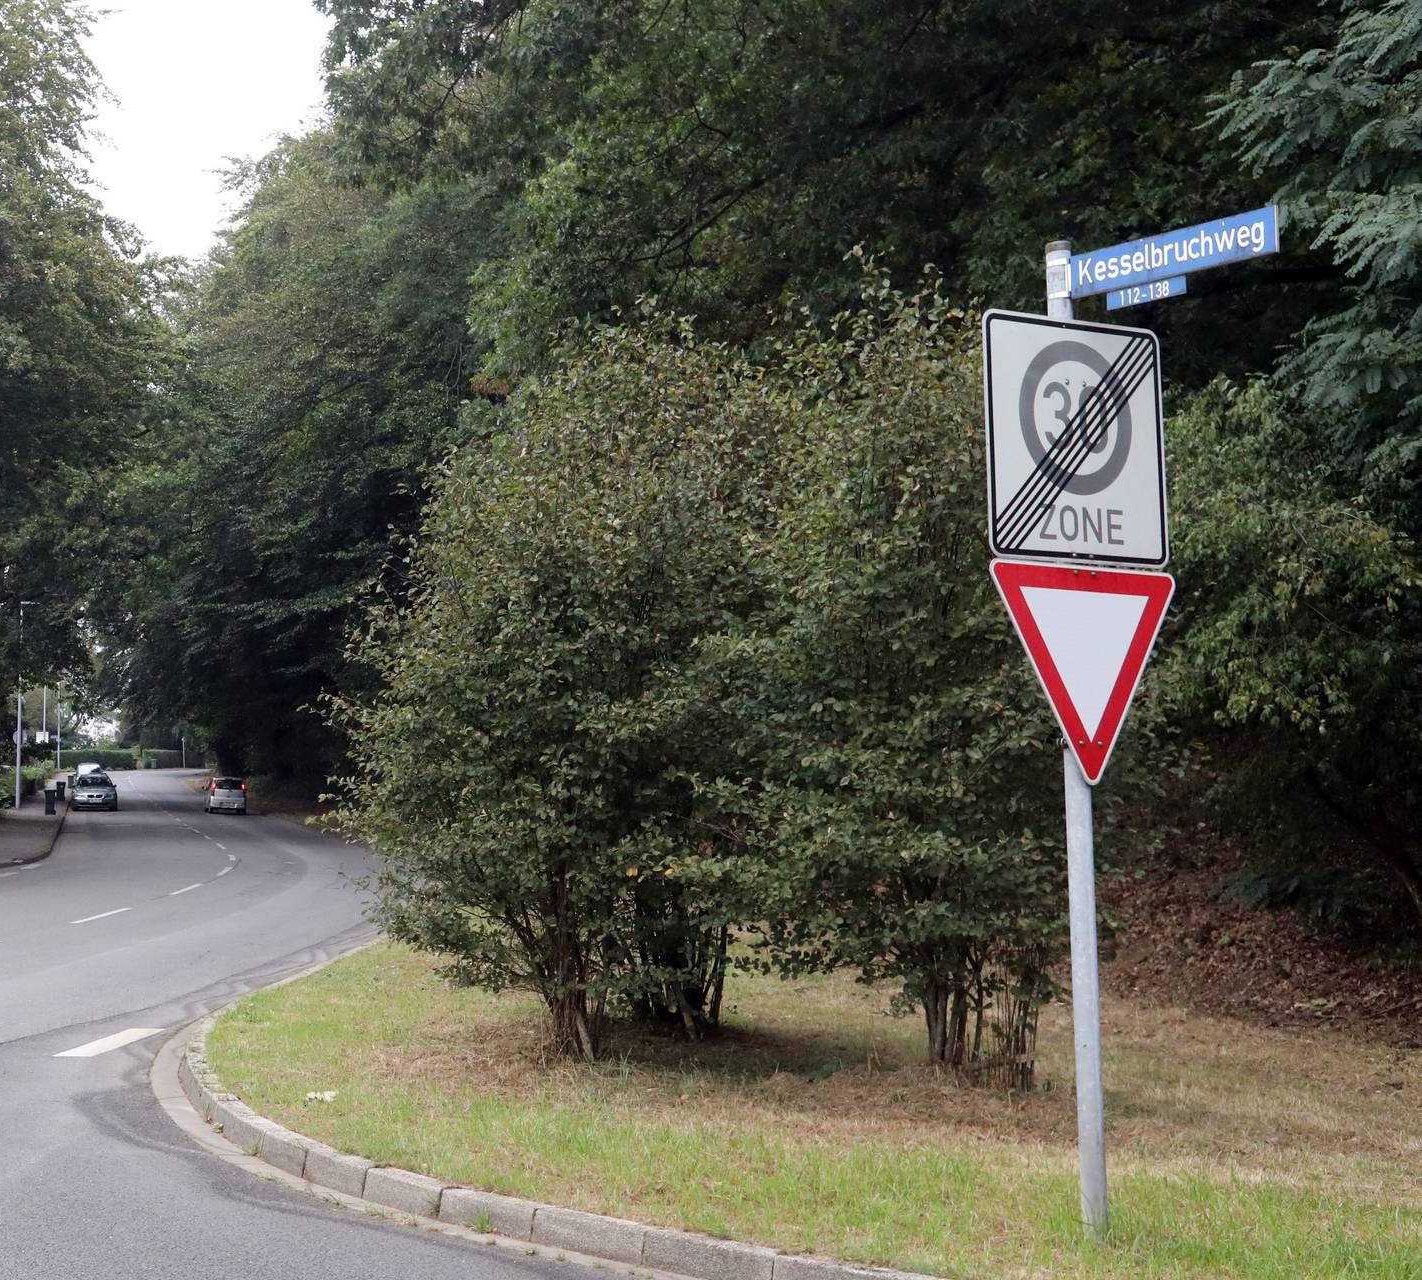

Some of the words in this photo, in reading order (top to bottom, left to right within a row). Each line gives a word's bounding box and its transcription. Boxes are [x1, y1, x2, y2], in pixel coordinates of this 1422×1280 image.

[1079, 221, 1265, 285] Kesselbruchweg
[1119, 281, 1170, 306] 112-138
[1043, 381, 1109, 454] 30
[1039, 503, 1124, 546] ZONE
